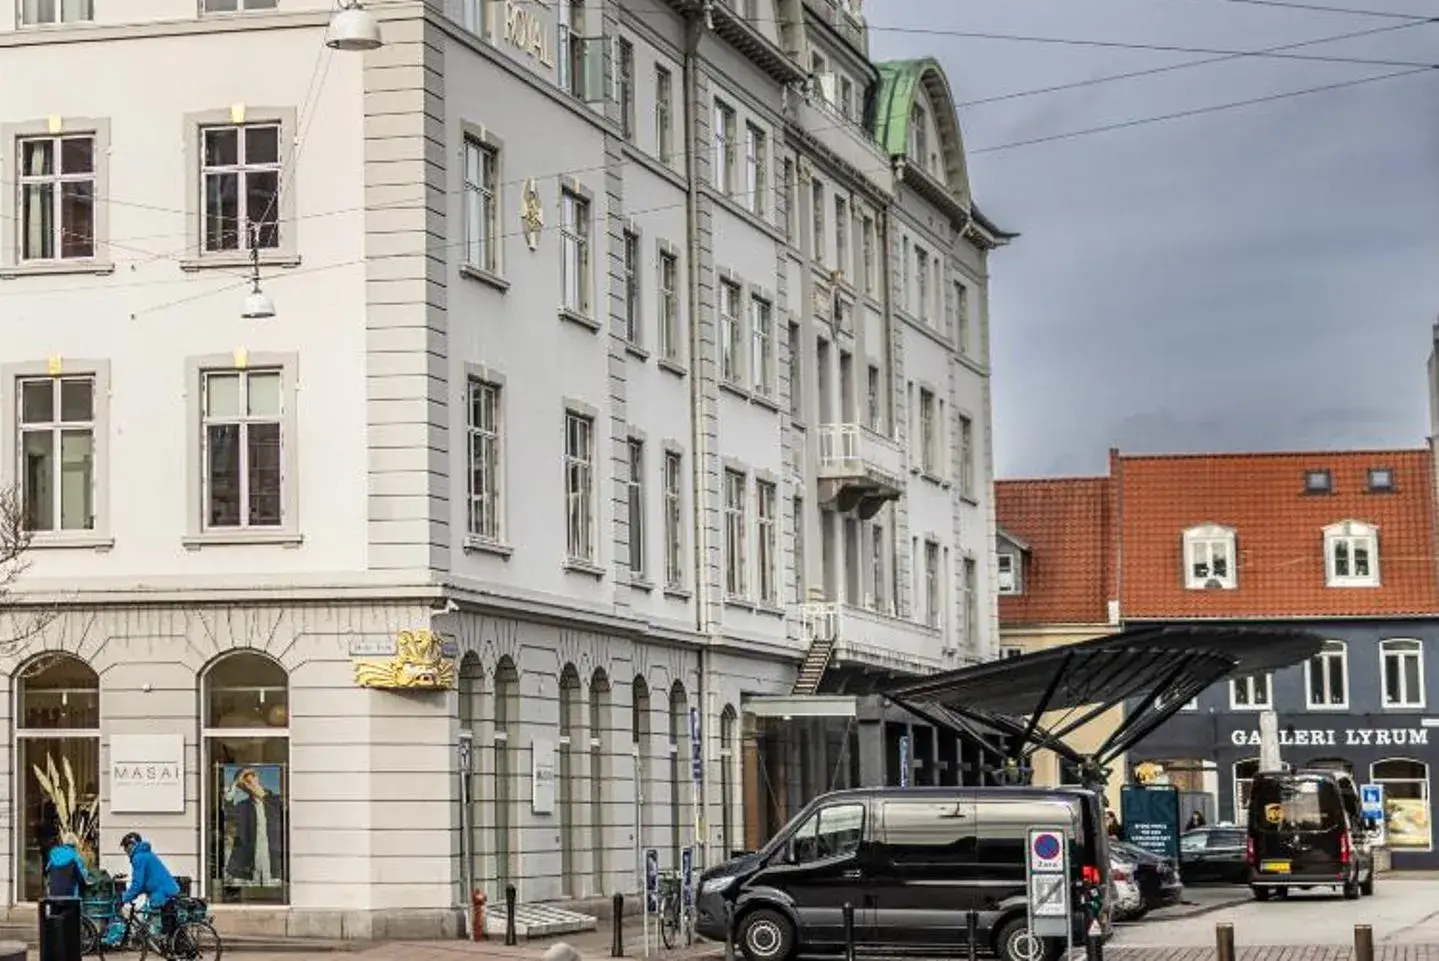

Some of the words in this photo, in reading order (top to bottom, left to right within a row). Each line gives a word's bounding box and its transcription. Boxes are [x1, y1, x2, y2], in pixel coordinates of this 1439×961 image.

[505, 0, 552, 67] ROYAL
[1231, 730, 1335, 745] GALERI
[1346, 729, 1428, 745] LYRUM
[114, 766, 179, 780] MASAI
